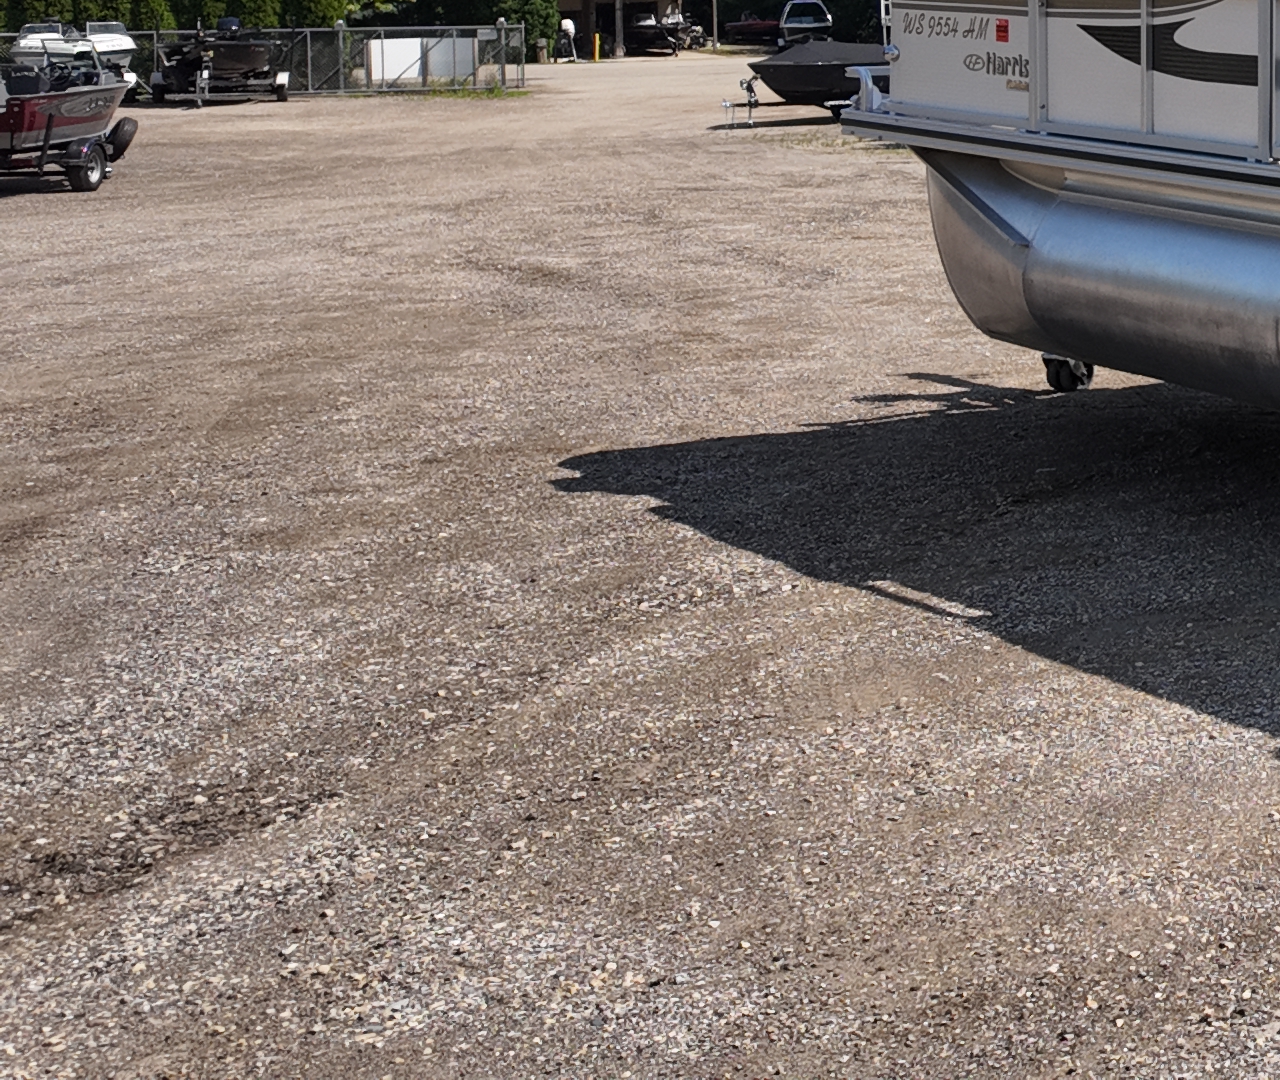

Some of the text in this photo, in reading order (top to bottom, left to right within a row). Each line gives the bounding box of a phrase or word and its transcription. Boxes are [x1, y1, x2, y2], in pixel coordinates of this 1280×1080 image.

[902, 12, 925, 36] WS
[927, 15, 959, 39] 9554
[985, 52, 1029, 78] Harris
